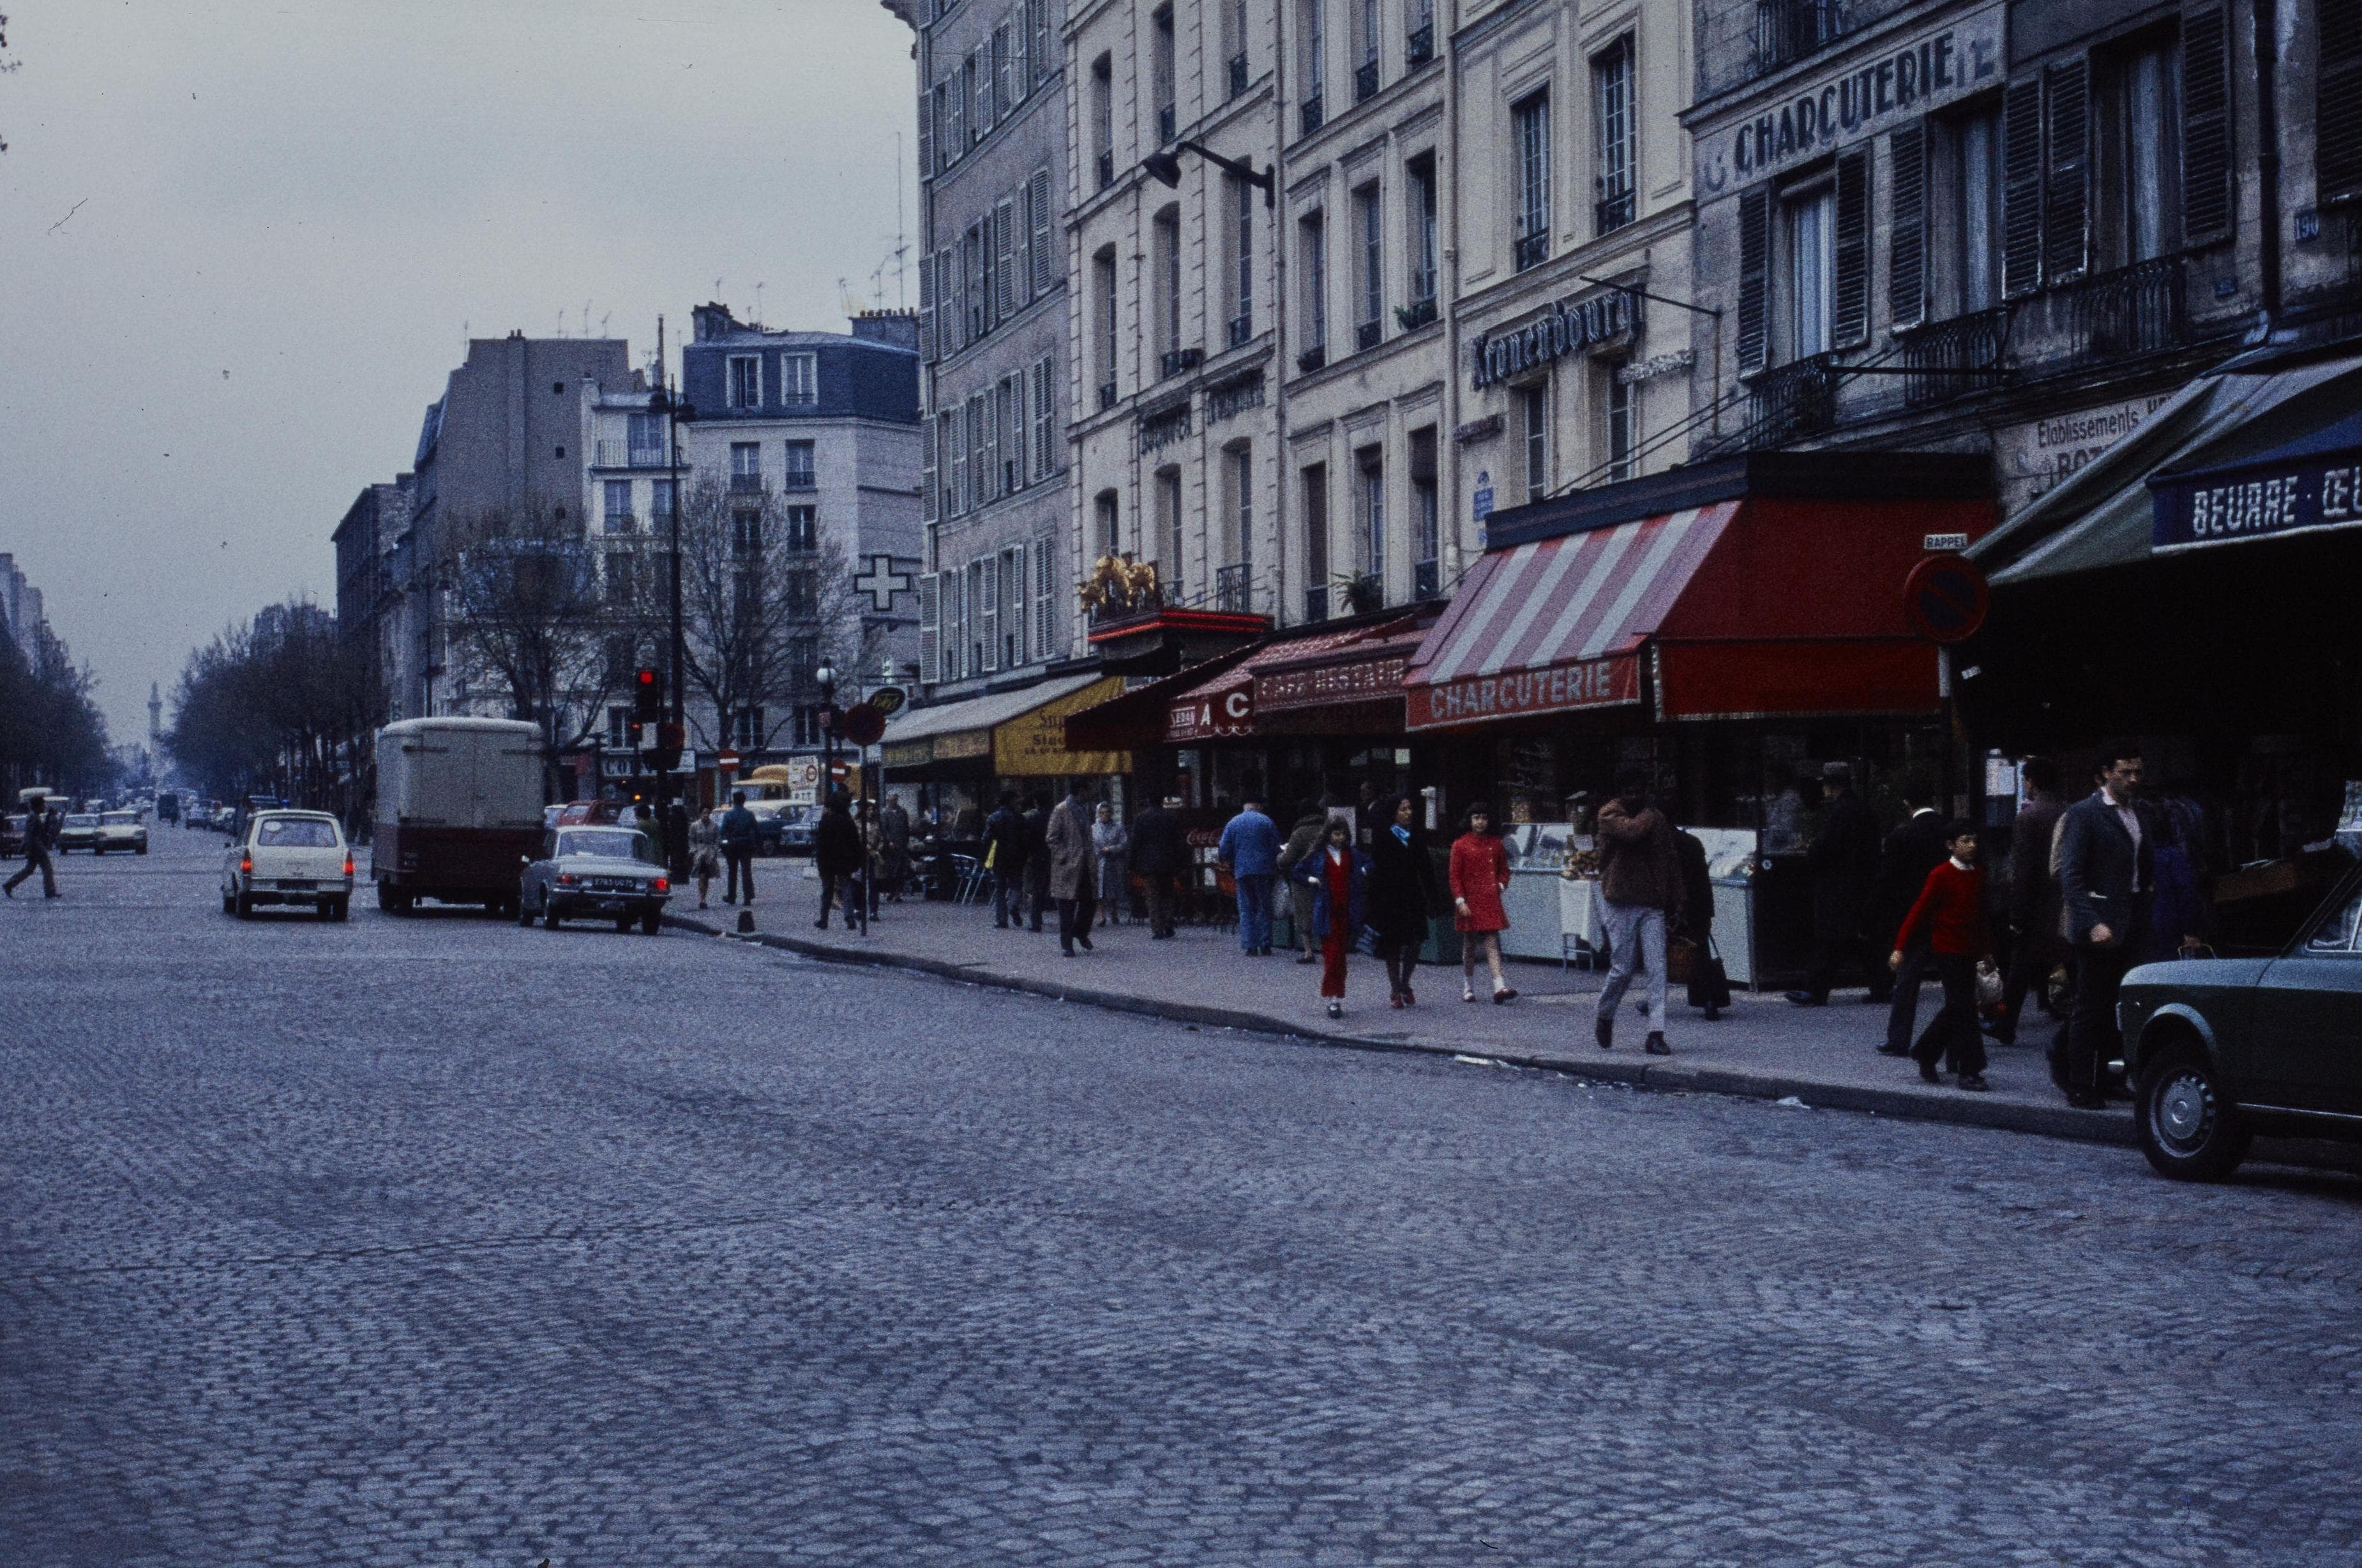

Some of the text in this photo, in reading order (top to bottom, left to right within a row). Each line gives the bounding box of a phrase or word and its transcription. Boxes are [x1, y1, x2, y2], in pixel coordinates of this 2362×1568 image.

[1734, 31, 1954, 172] CHARCUTERIE
[2296, 214, 2319, 240] 190
[2192, 475, 2298, 537] BEURRE
[1926, 536, 1966, 549] RAPPEL
[1431, 662, 1612, 719] CHARCUTERIE
